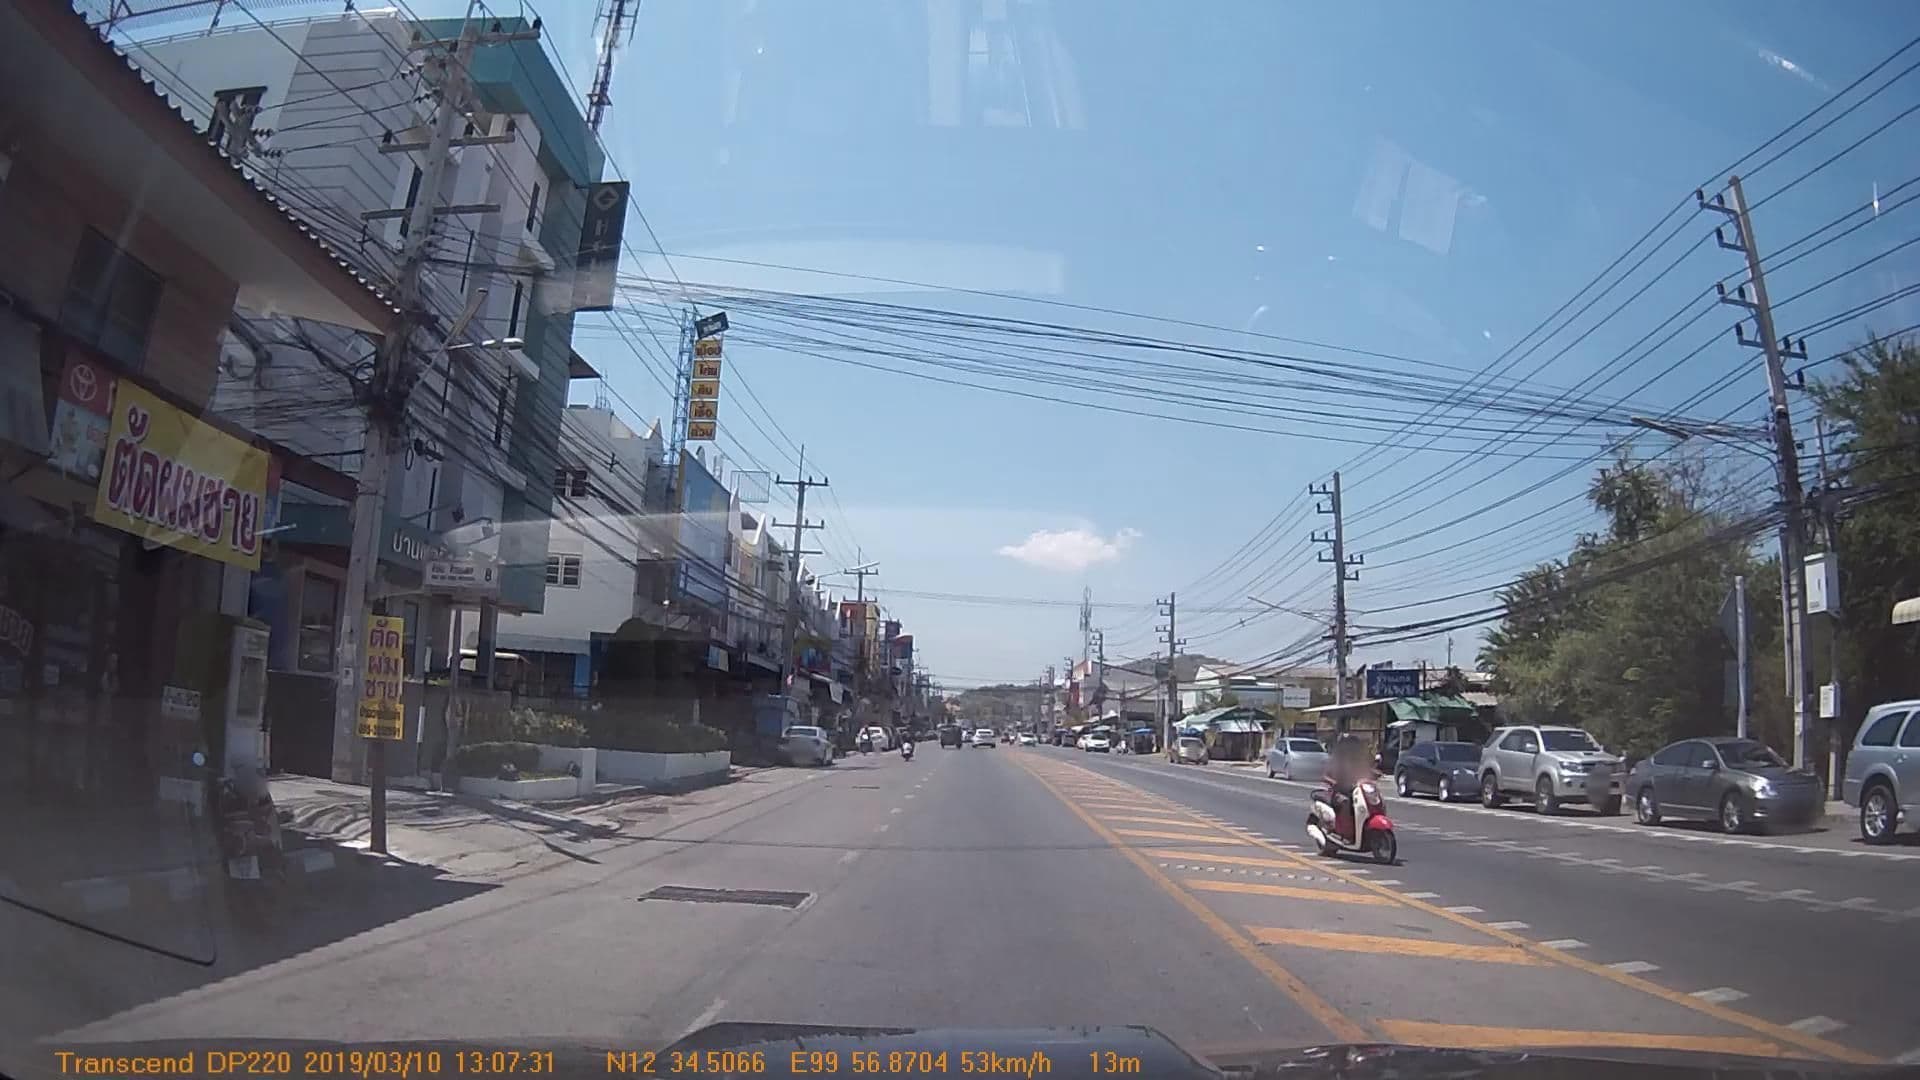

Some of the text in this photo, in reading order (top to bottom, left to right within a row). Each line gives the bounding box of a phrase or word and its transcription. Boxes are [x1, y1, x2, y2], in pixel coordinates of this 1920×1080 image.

[108, 405, 260, 554] ตัดผมชาย
[370, 619, 400, 649] ตัด
